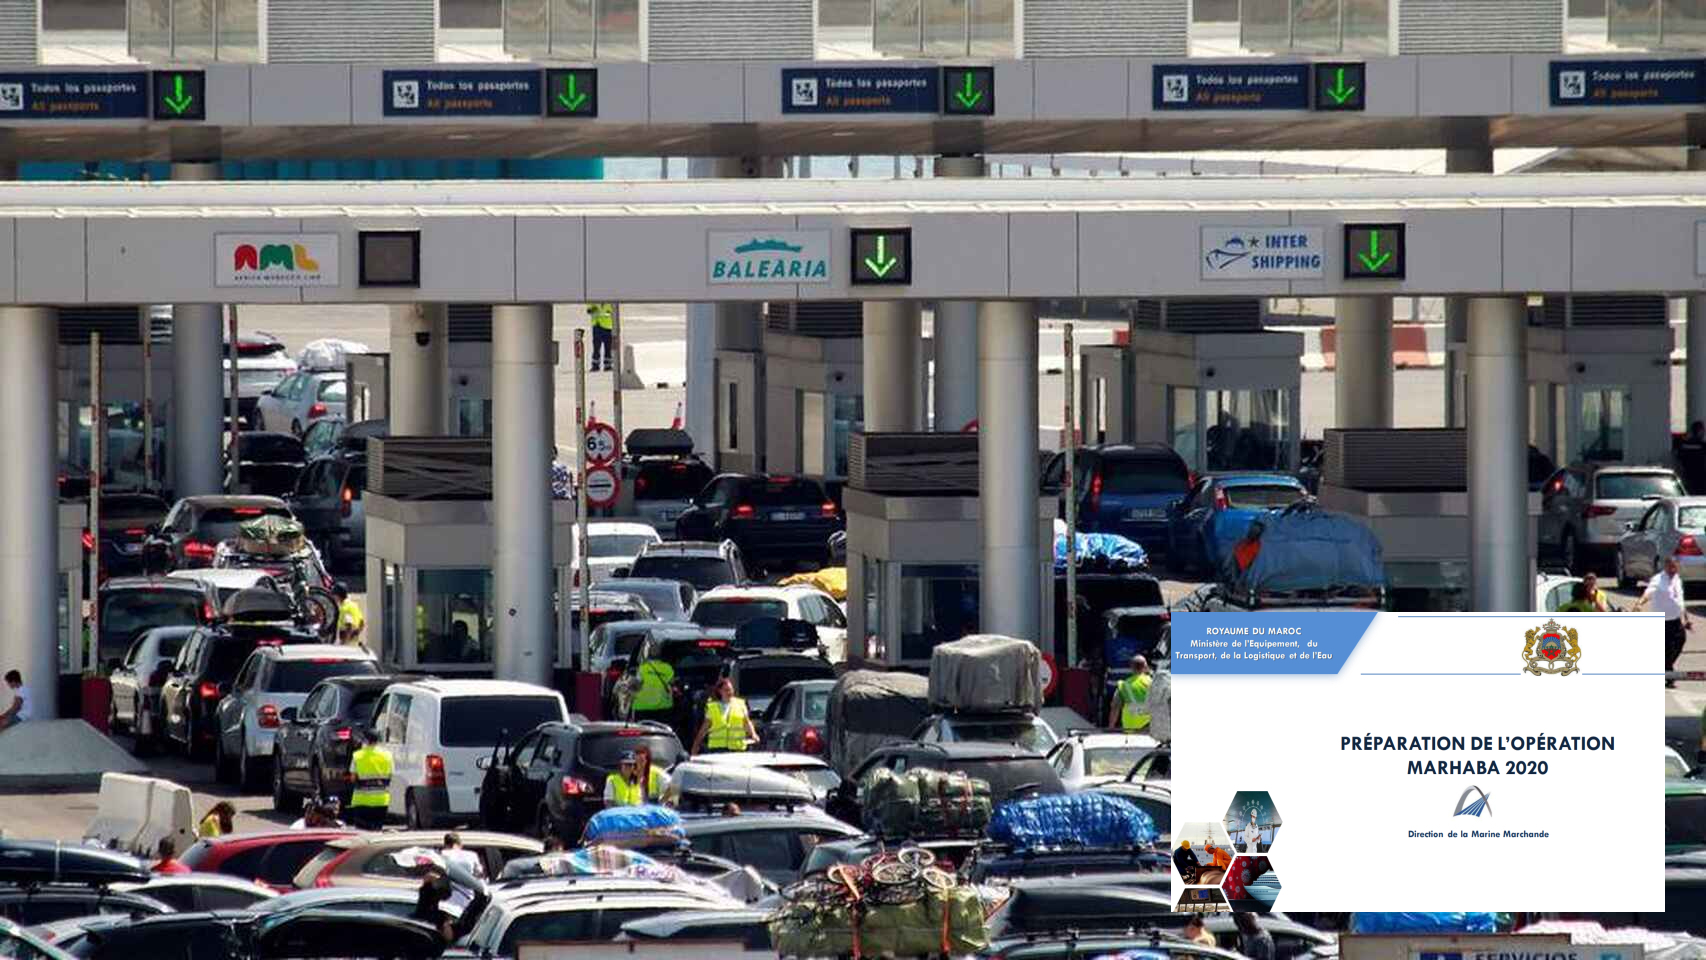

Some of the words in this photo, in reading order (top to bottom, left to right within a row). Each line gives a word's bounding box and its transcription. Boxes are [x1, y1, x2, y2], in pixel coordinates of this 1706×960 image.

[427, 80, 454, 91] Todos
[478, 80, 529, 92] pasaportes
[825, 78, 852, 88] Todos
[875, 78, 927, 90] pasaportes
[1196, 75, 1224, 85] Todos
[1247, 75, 1299, 87] pasaportes
[31, 83, 60, 93] Todos
[83, 83, 136, 95] pasaportes
[1265, 235, 1308, 249] INTER
[234, 244, 319, 271] AML
[1251, 254, 1321, 270] SHIPPING
